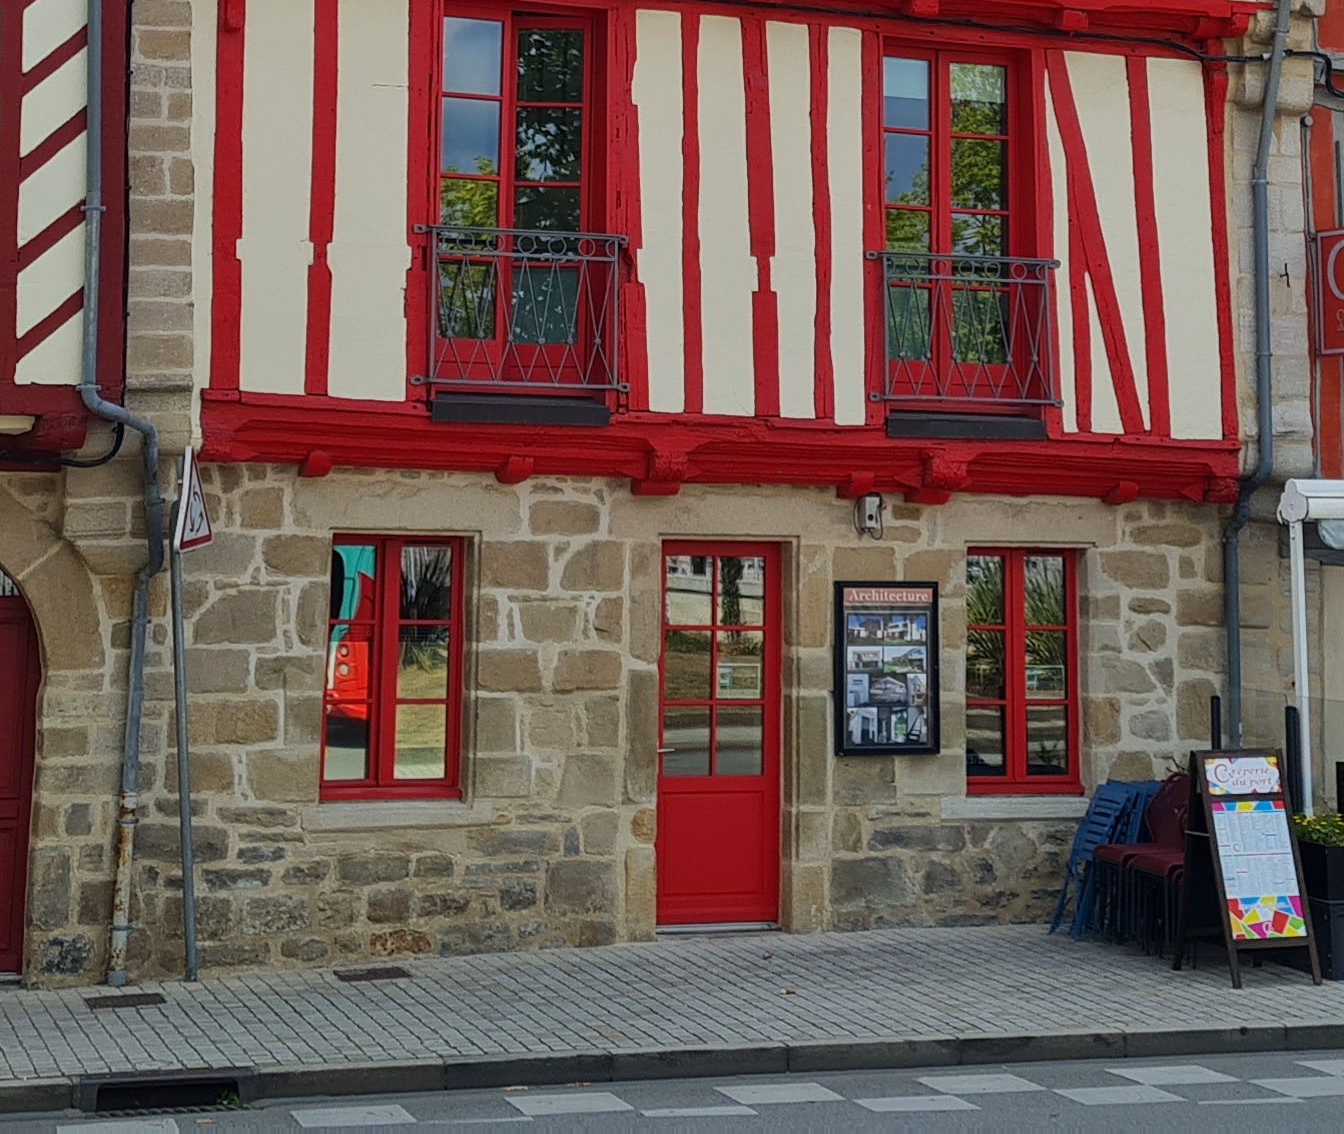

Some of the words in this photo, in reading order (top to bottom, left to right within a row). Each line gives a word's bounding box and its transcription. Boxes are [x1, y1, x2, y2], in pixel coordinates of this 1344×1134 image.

[849, 588, 929, 602] Architecture
[1214, 764, 1270, 783] Crêperie
[1232, 778, 1246, 786] du
[1249, 778, 1272, 787] port
